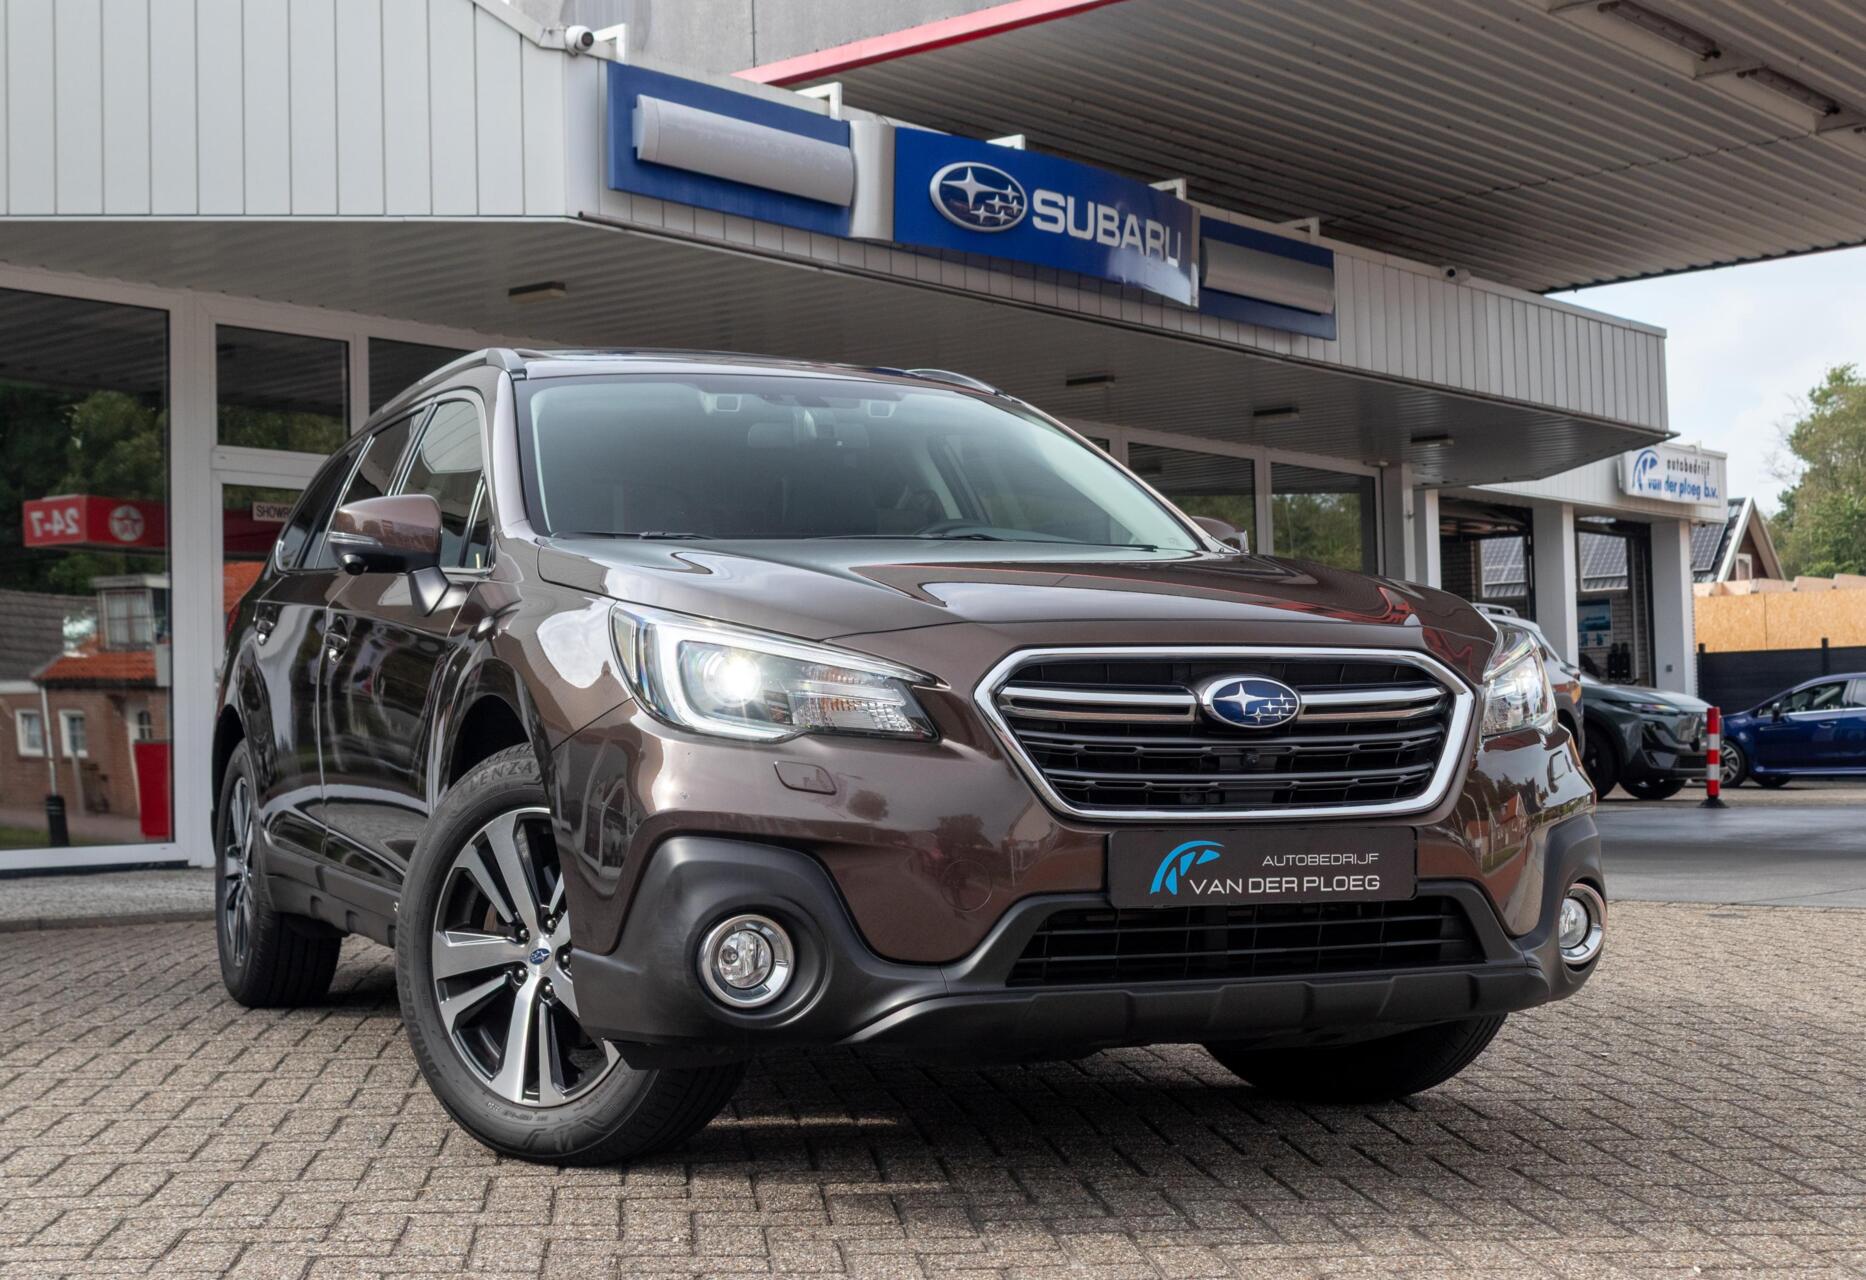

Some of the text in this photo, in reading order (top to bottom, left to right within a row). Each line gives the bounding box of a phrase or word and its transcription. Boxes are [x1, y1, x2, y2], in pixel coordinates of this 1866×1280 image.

[1032, 188, 1182, 268] SUBARU
[1666, 457, 1710, 478] autobedrijf
[1648, 474, 1719, 501] van der ploeg b.v.
[1262, 853, 1380, 867] AUTOBEDRIJF
[1188, 875, 1381, 896] VAN DER PLOEG
